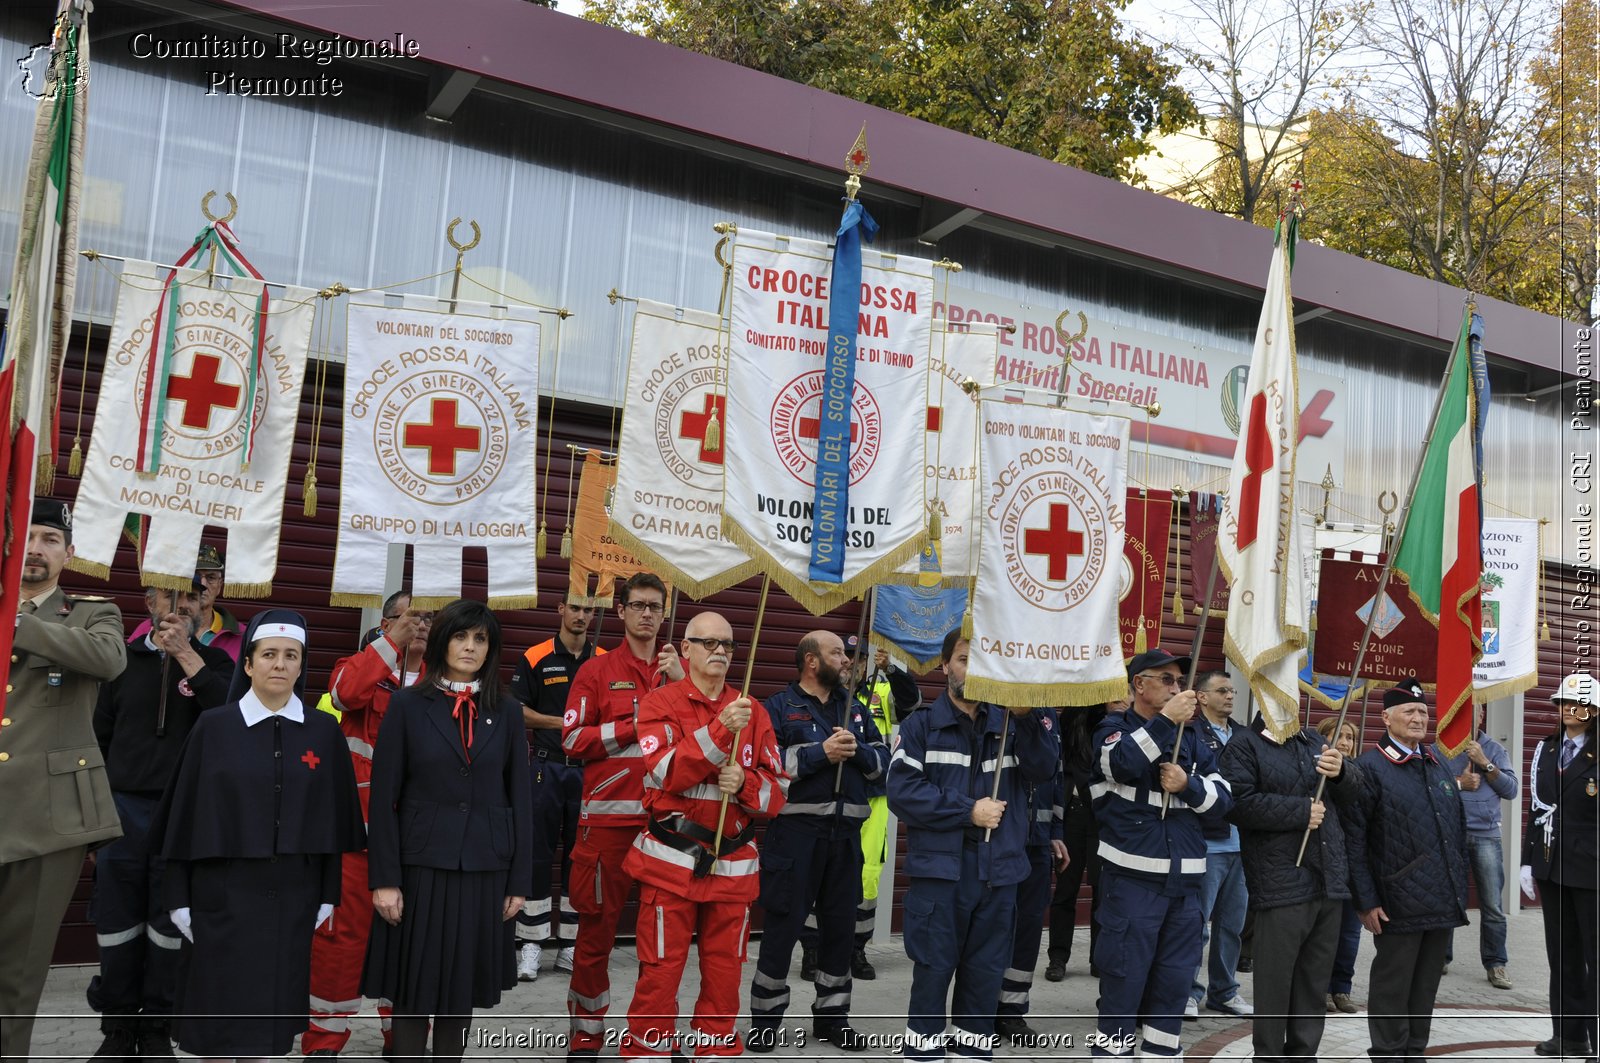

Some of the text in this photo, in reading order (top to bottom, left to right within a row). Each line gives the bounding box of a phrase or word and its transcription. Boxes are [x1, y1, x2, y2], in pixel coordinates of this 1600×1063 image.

[748, 265, 917, 315] CROCE OSSA
[376, 321, 513, 345] VOLONTARI DEL SOCCORSO
[777, 300, 888, 339] ITALNA
[187, 330, 248, 361] GINEVRA
[241, 314, 293, 394] ILIANA
[746, 329, 914, 369] COMITATO PROVLE DI TORINO
[1023, 321, 1102, 366] ROSSA
[1110, 341, 1209, 389] ITALIANA
[351, 346, 532, 432] CROCE ROSSA ITALIANA
[641, 344, 729, 403] CROCE ROSS
[1077, 371, 1158, 407] Speciali
[794, 381, 808, 398] DI
[856, 394, 871, 410] 22
[378, 374, 504, 498] CONVENZIONE DI GINEVRA 22 AGOSTO 1864
[658, 369, 726, 481] CONVENZIONE DI GINE
[774, 393, 807, 473] CONVENZIONE
[863, 411, 878, 457] AGOSTO
[985, 421, 1014, 436] CORPO
[1019, 425, 1065, 443] VOLONTARI
[1069, 431, 1082, 446] DEL
[204, 433, 239, 453] 1864
[816, 335, 850, 565] VOLONTARI DEL SOCCORSO
[1019, 446, 1073, 470] ROSSA
[110, 455, 264, 493] COTATO LOCALE
[175, 482, 192, 495] DI
[925, 465, 977, 481] OCALE
[120, 487, 242, 522] MONCALIERI
[634, 490, 723, 516] SOTTOCOM
[757, 493, 892, 525] VOLONI DEL
[351, 514, 527, 538] GRUPPO DI LA LOGGIA
[632, 513, 729, 543] CARMAG
[776, 522, 875, 549] SOCRSO
[945, 526, 962, 534] 1974
[1003, 476, 1104, 604] CONVENZIONE DI GINEVRA 22 AGOSTO 1864
[1129, 538, 1160, 581] PIEMONTE
[1485, 561, 1519, 570] ONDO
[1146, 619, 1157, 629] DI
[980, 637, 1090, 661] CASTAGNOLE
[1353, 642, 1404, 656] SZIONE
[1337, 662, 1417, 678] NIHELINO
